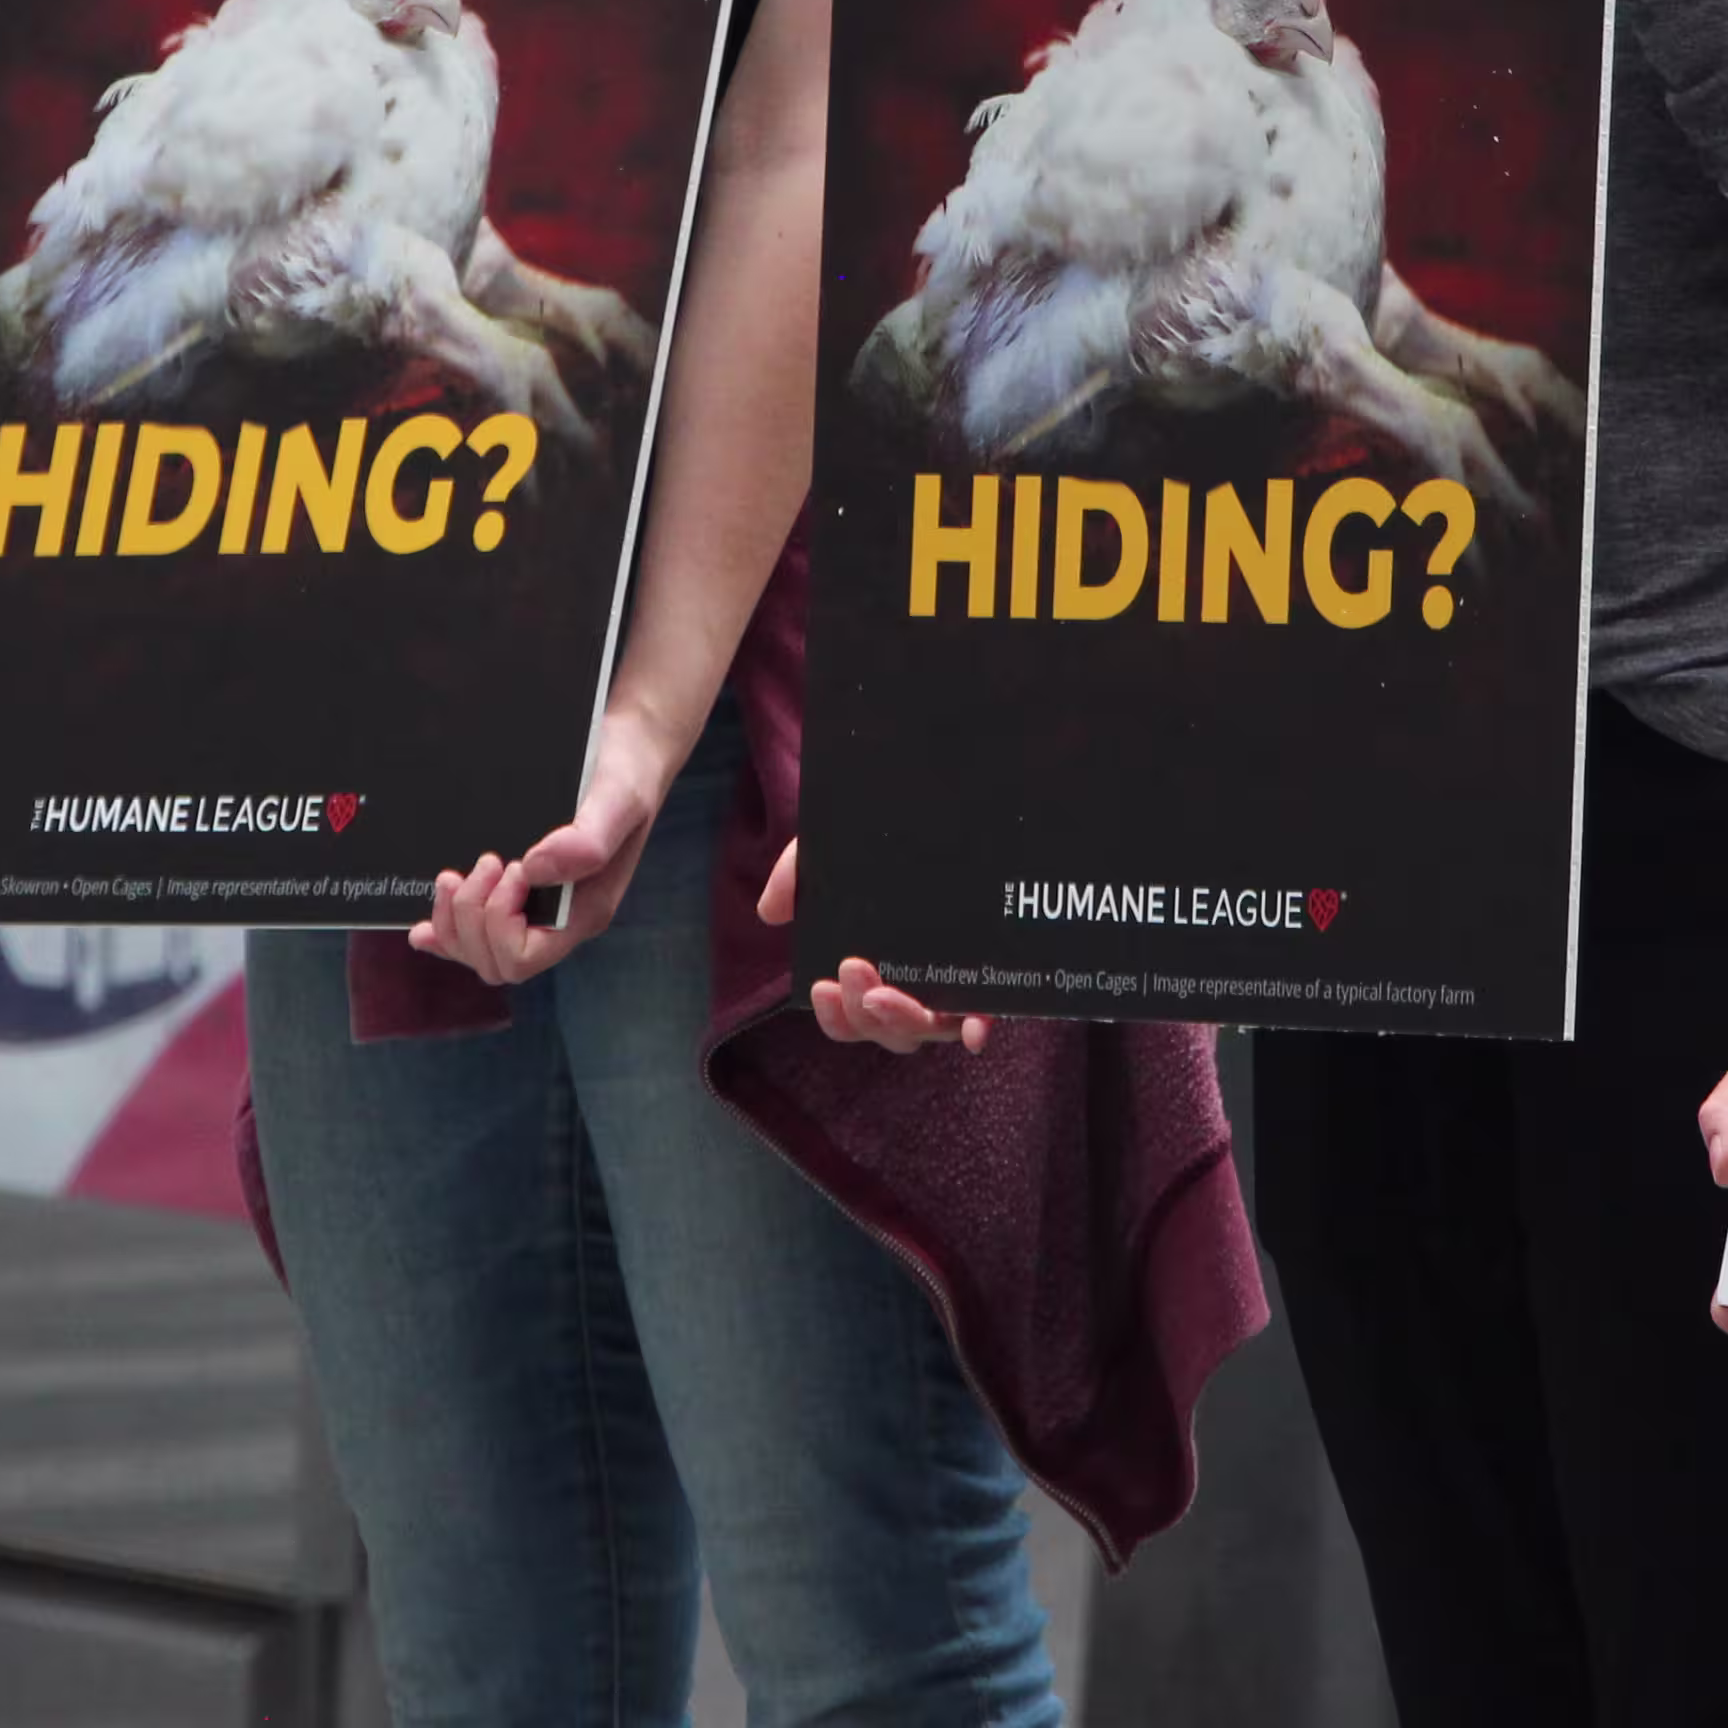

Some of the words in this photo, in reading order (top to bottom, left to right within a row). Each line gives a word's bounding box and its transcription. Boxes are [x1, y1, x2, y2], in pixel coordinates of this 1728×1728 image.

[909, 474, 1476, 631] HIDING?
[44, 796, 192, 832] HUMANE
[194, 796, 324, 832] LEAGUE
[0, 876, 59, 896] Skowron
[71, 877, 108, 900] Open
[112, 877, 152, 901] Cages
[167, 878, 210, 901] Image
[212, 878, 311, 901] representative
[313, 876, 330, 896] of
[331, 881, 339, 896] a
[343, 878, 388, 901] typical
[1004, 882, 1014, 917] THE
[1017, 881, 1165, 923] HUMANE
[1174, 887, 1304, 929] LEAGUE
[925, 963, 978, 985] Andrew
[981, 965, 1041, 988] Skowron
[1054, 969, 1092, 993] Open
[1096, 971, 1137, 997] Cages
[1153, 973, 1195, 998] Image
[1200, 975, 1302, 1001] representative
[1305, 978, 1321, 999] of
[1323, 983, 1332, 999] a
[1335, 980, 1383, 1005] typical
[1386, 981, 1438, 1009] factory
[1440, 983, 1475, 1005] farm
